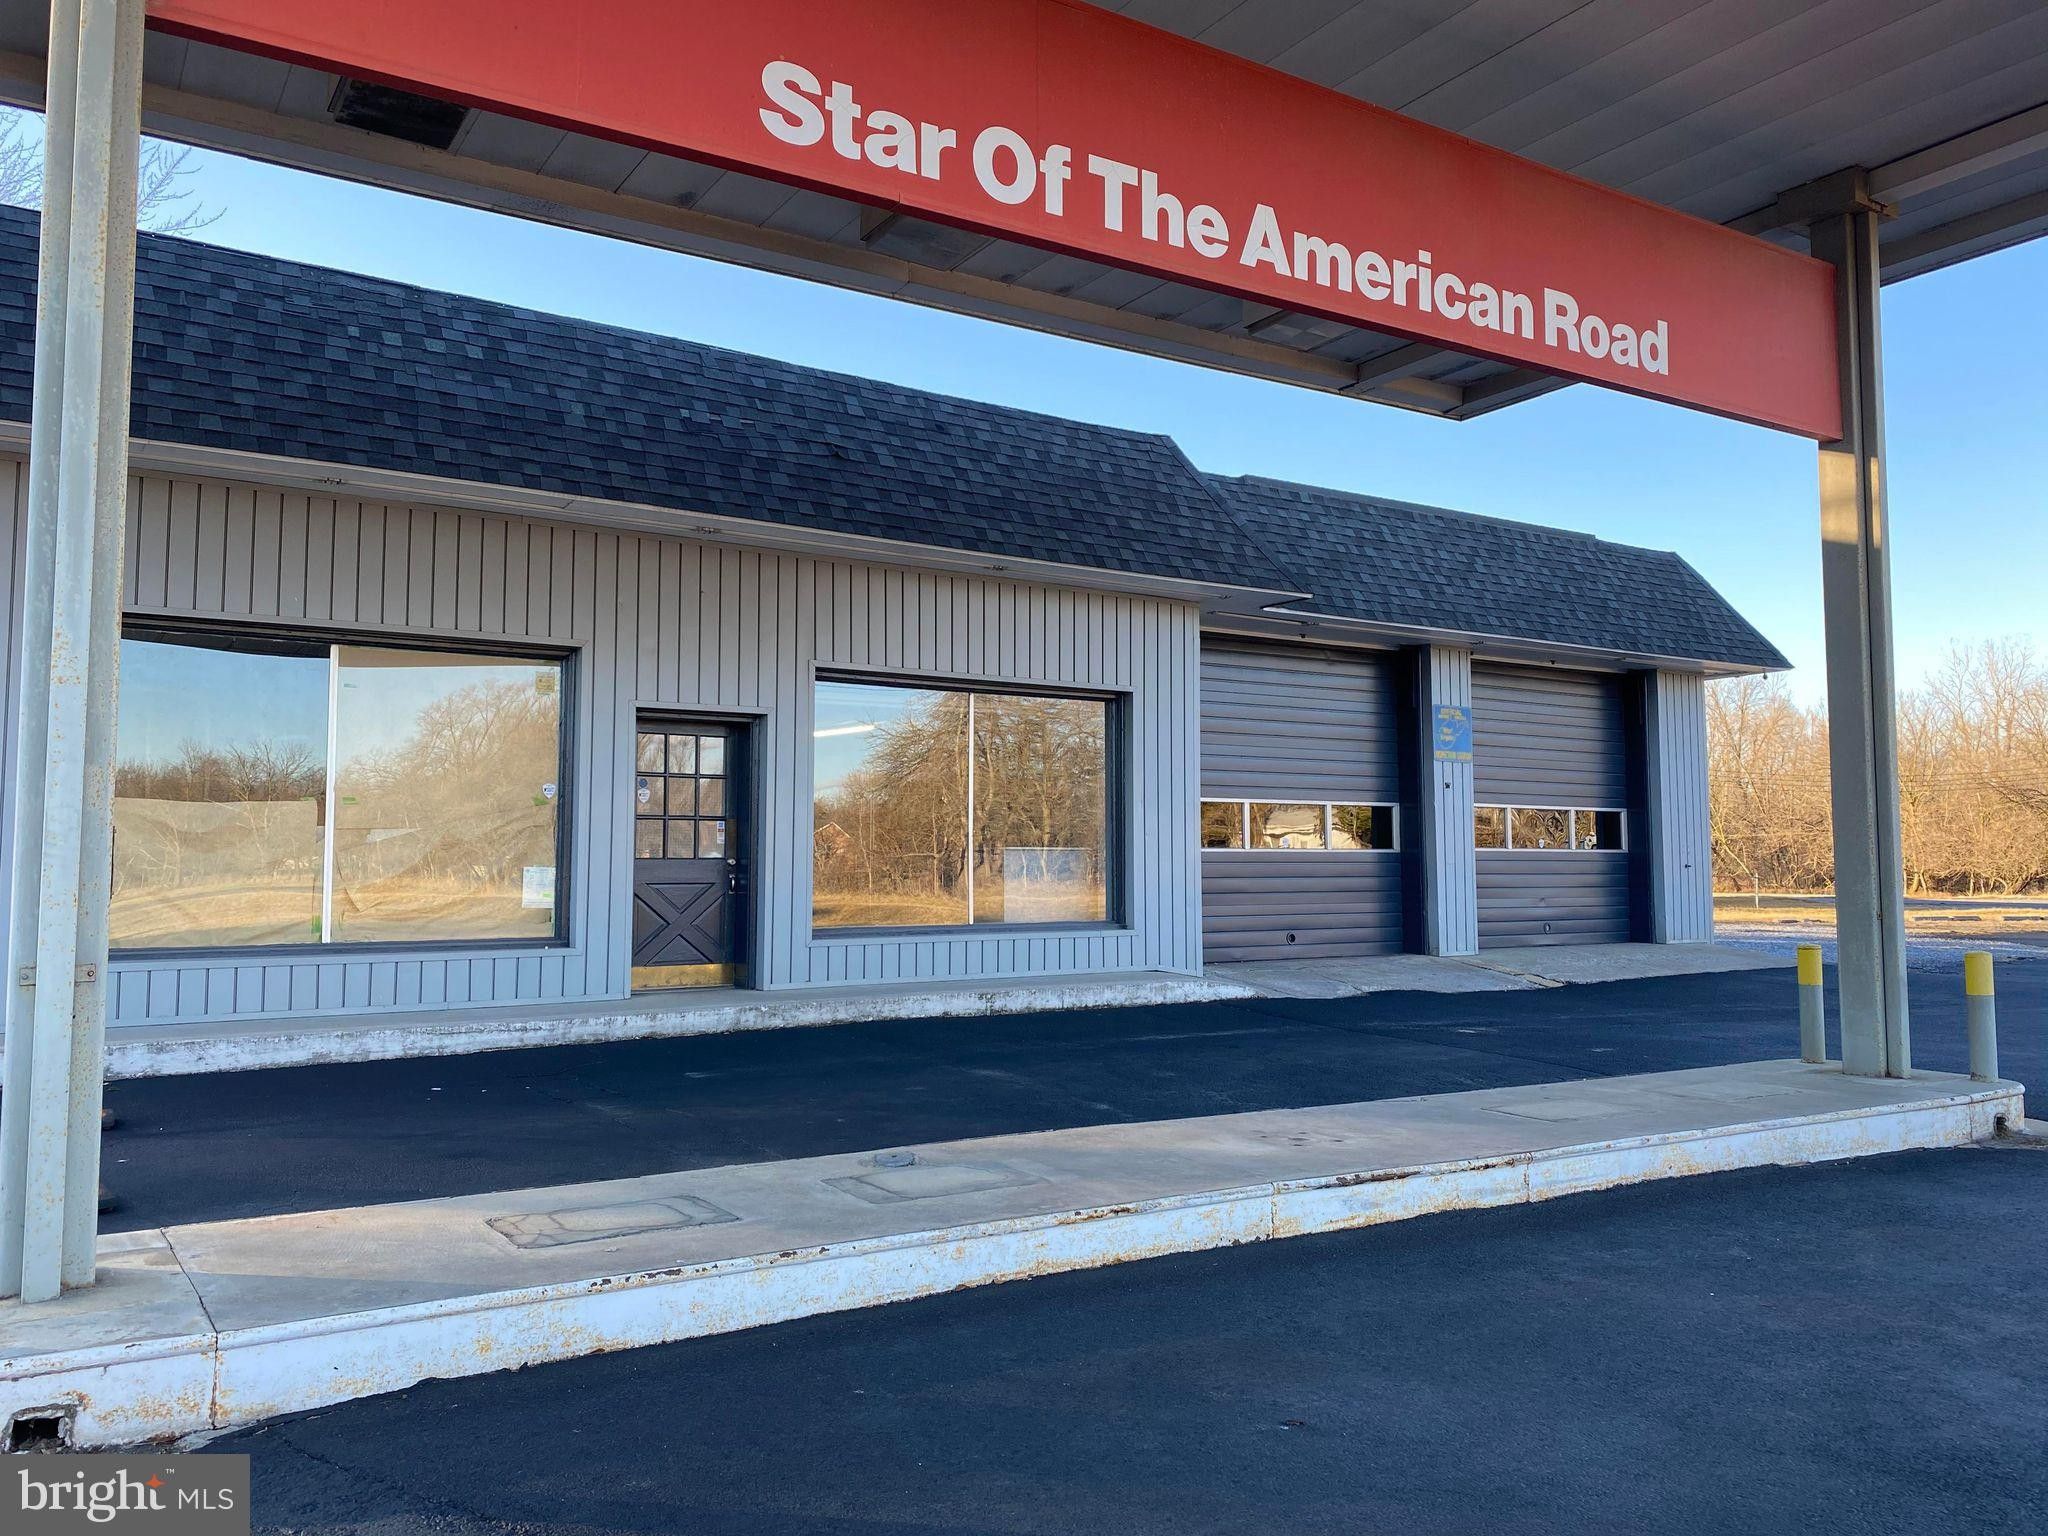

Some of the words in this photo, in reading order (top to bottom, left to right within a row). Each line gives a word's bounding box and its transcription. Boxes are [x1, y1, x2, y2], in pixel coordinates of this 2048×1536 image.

[759, 60, 957, 181] Star
[972, 126, 1072, 217] Of
[1088, 153, 1230, 259] The
[1239, 203, 1535, 340] American
[1543, 287, 1670, 376] Road
